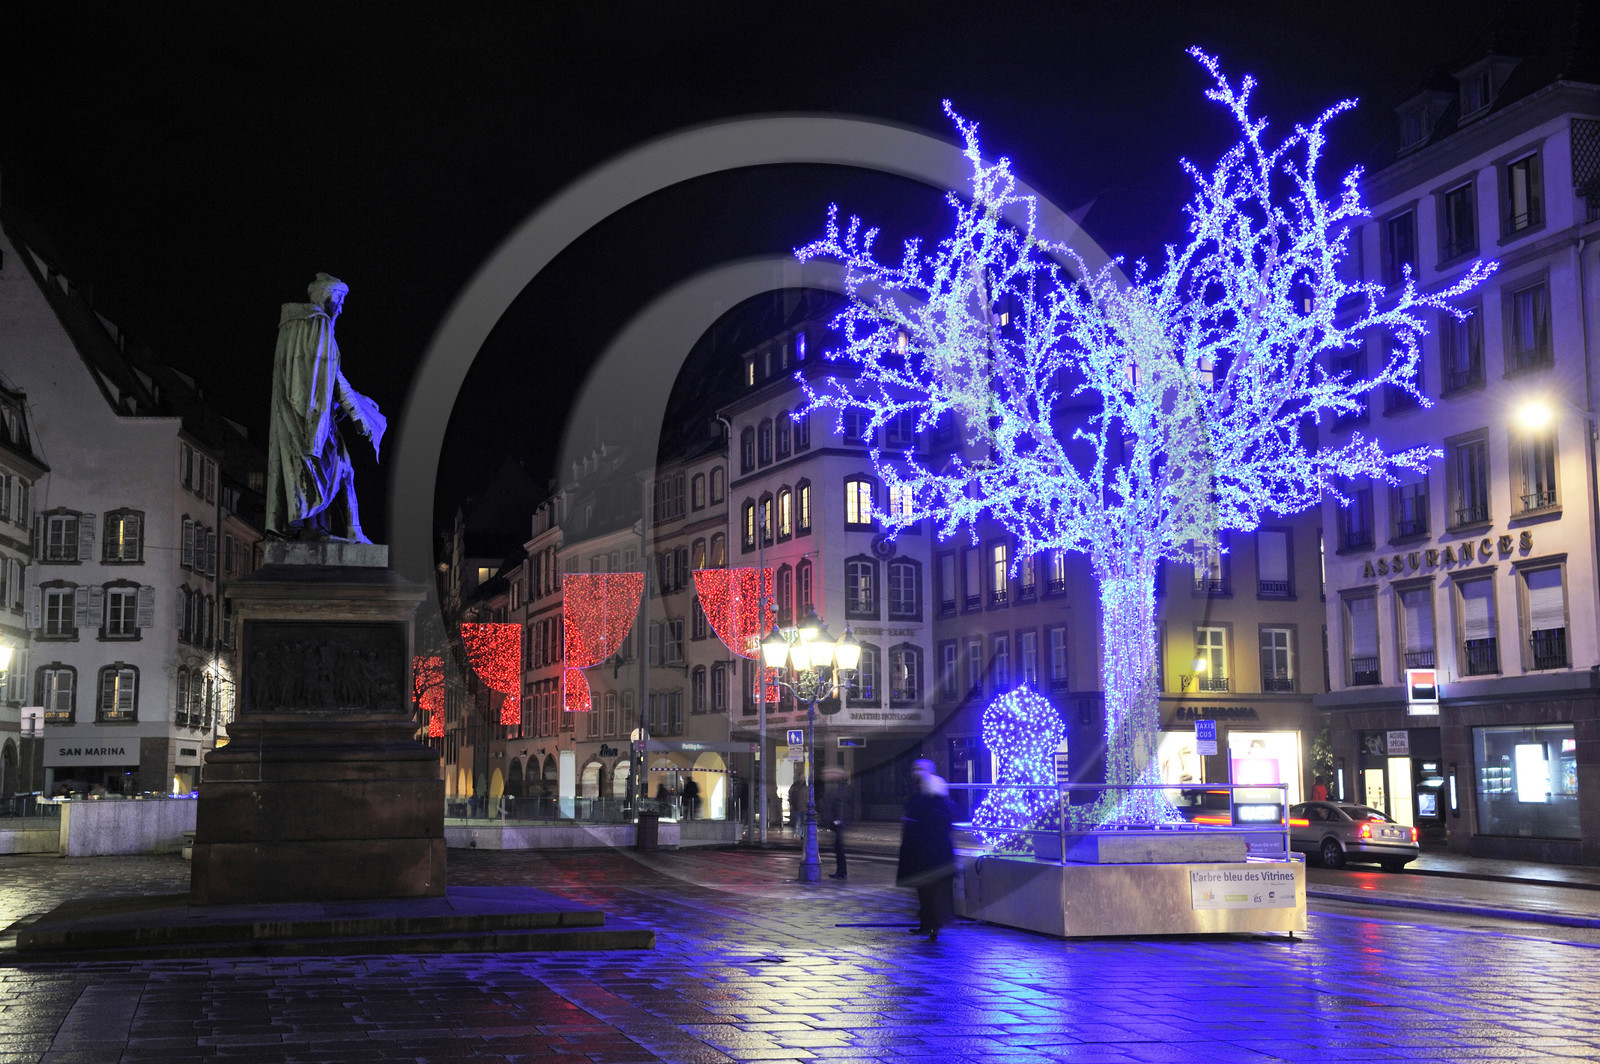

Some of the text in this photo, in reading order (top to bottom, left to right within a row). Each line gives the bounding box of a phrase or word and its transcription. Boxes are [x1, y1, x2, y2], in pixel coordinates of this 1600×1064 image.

[1363, 530, 1533, 578] ASSURANCES
[59, 747, 126, 756] SAN MARINA
[1192, 871, 1295, 882] L'arbre bleu des Vitrines
